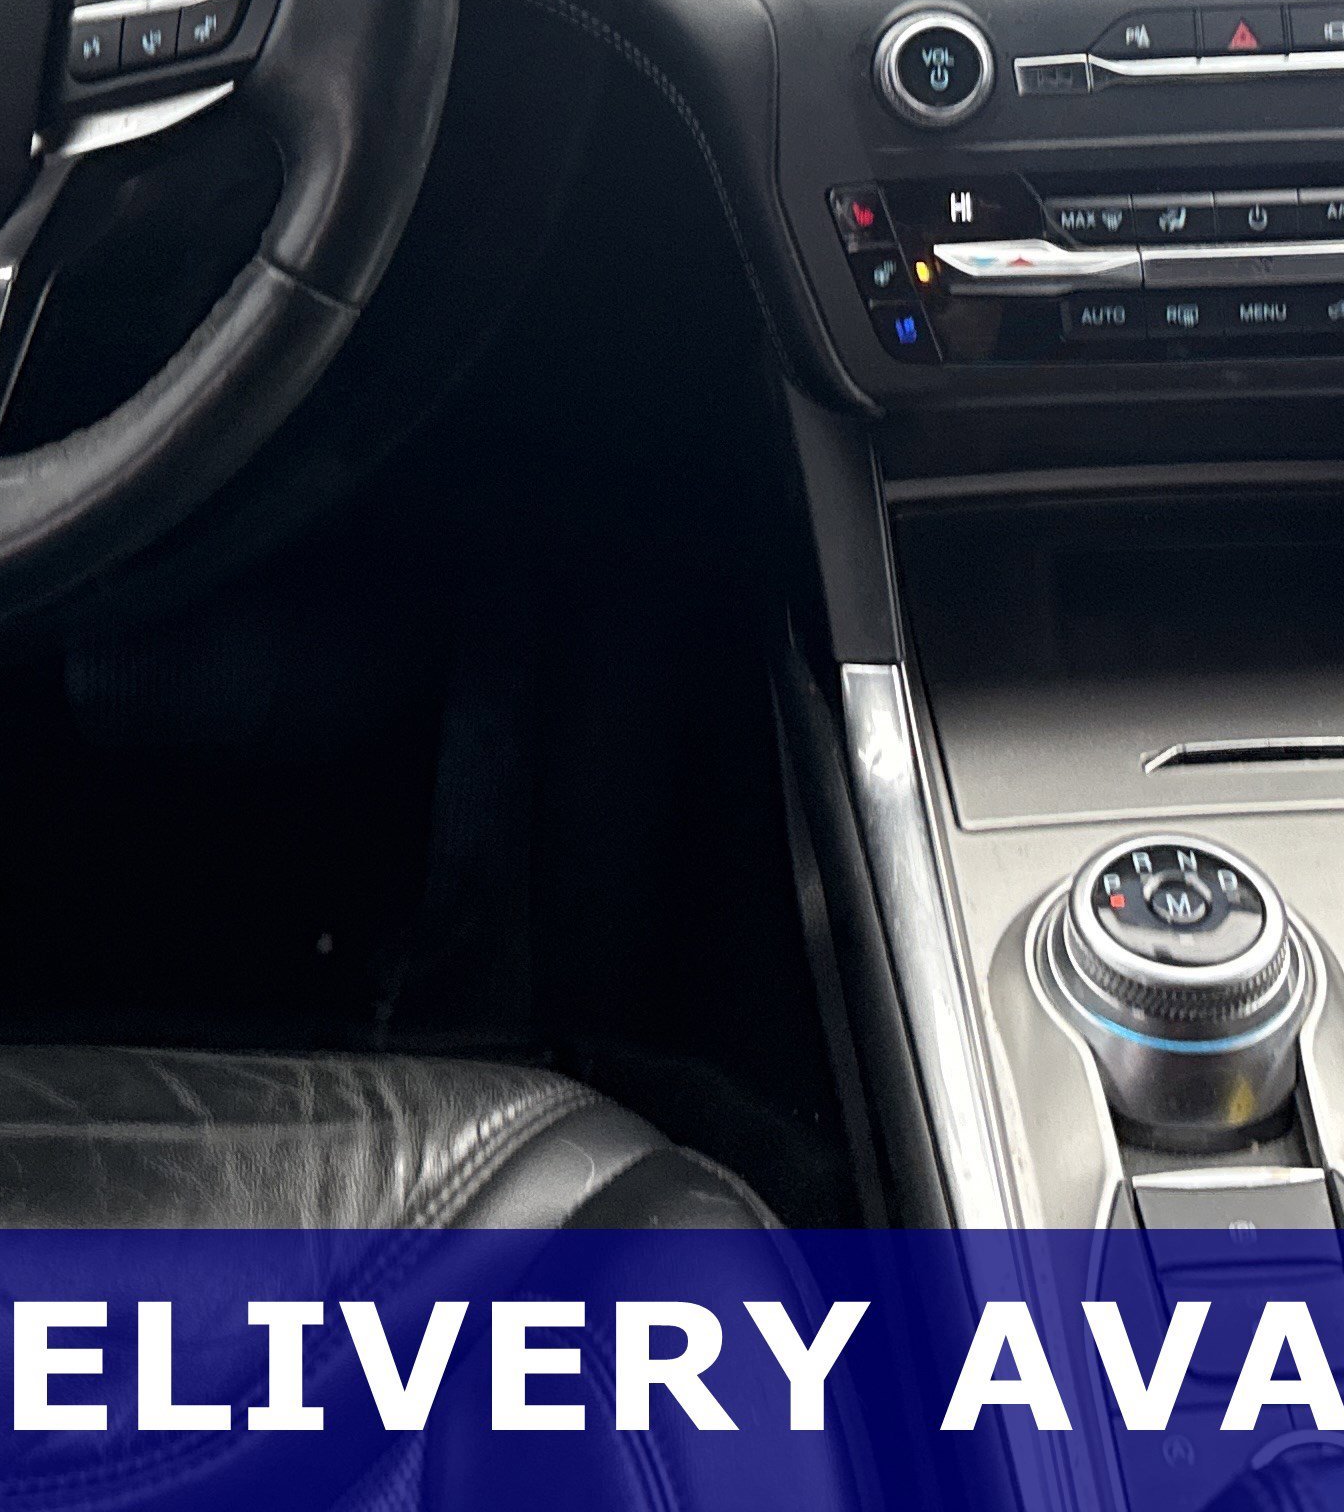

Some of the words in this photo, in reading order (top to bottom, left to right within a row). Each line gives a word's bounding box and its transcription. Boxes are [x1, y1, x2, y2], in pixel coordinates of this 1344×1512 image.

[921, 46, 955, 67] VOL
[949, 191, 972, 223] HI
[1061, 209, 1097, 231] MAX
[1081, 304, 1126, 326] AUTO
[1239, 301, 1288, 323] MENU
[1131, 850, 1153, 875] R
[1176, 849, 1198, 874] N
[1103, 872, 1121, 896] P
[1217, 868, 1239, 892] D
[1164, 891, 1194, 918] M
